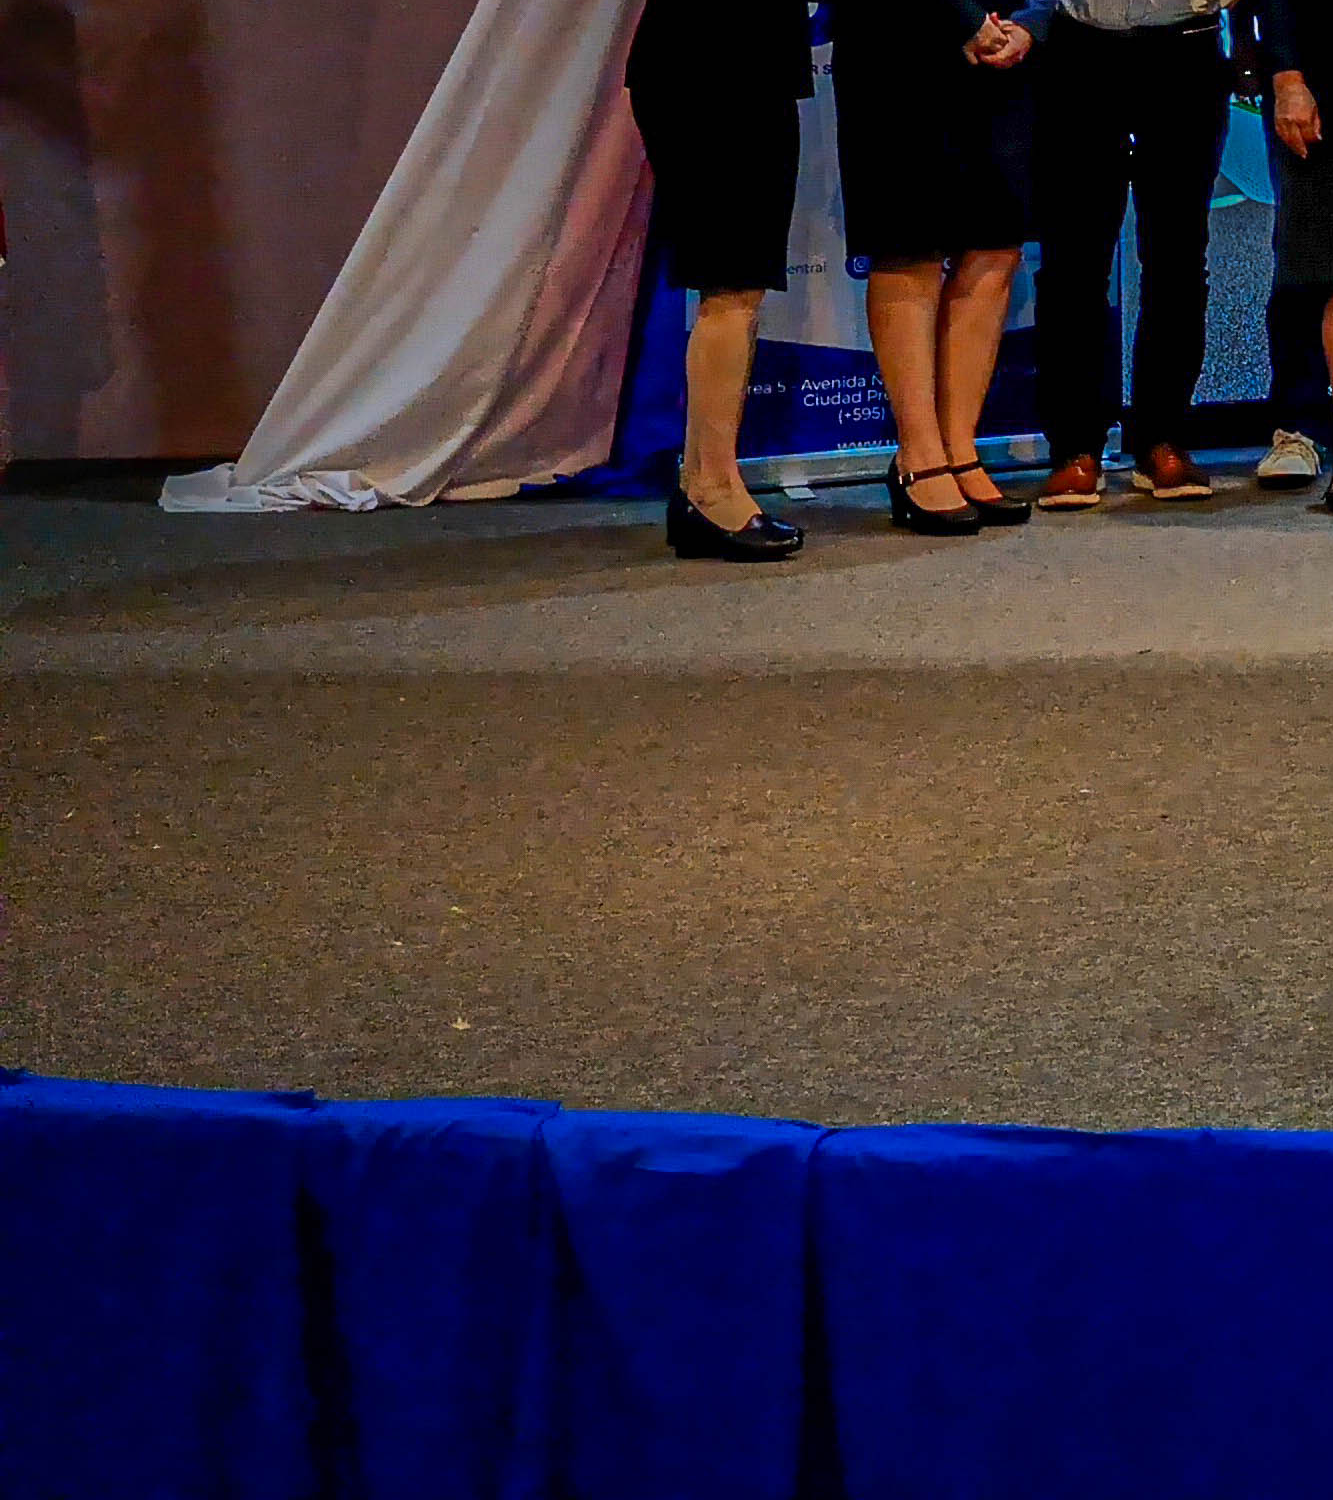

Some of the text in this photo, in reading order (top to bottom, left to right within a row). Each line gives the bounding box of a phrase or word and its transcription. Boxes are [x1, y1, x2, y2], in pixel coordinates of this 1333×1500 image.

[801, 375, 867, 391] Avenida
[803, 391, 863, 407] Ciudad
[838, 406, 886, 425] (+595)
